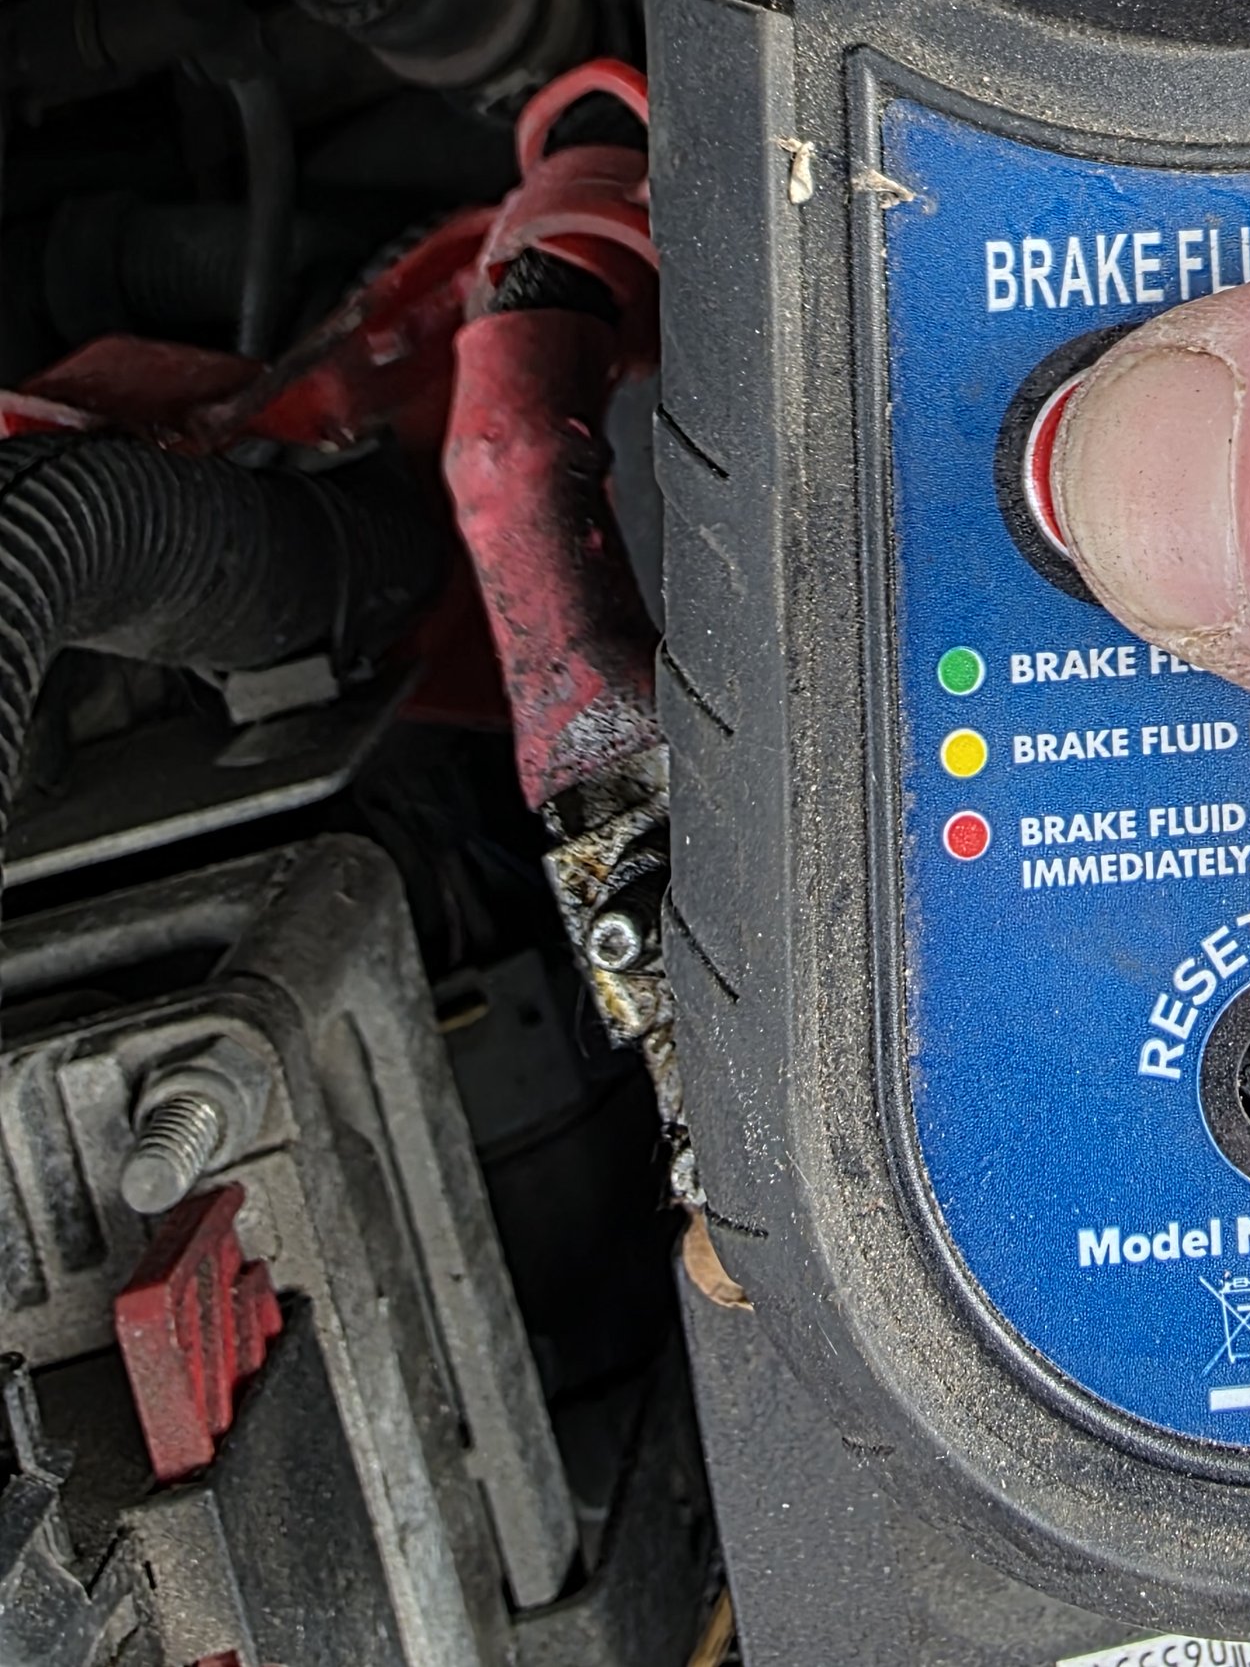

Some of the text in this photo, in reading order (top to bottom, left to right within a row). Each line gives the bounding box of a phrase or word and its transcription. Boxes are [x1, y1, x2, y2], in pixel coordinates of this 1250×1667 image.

[985, 231, 1165, 312] BRAKE
[1010, 644, 1206, 684] BRAKE FL
[1013, 728, 1130, 764] BRAKE
[1141, 721, 1239, 755] FLUID
[1020, 809, 1138, 847] BRAKE
[1149, 803, 1247, 838] FLUID
[1078, 1217, 1222, 1268] Model
